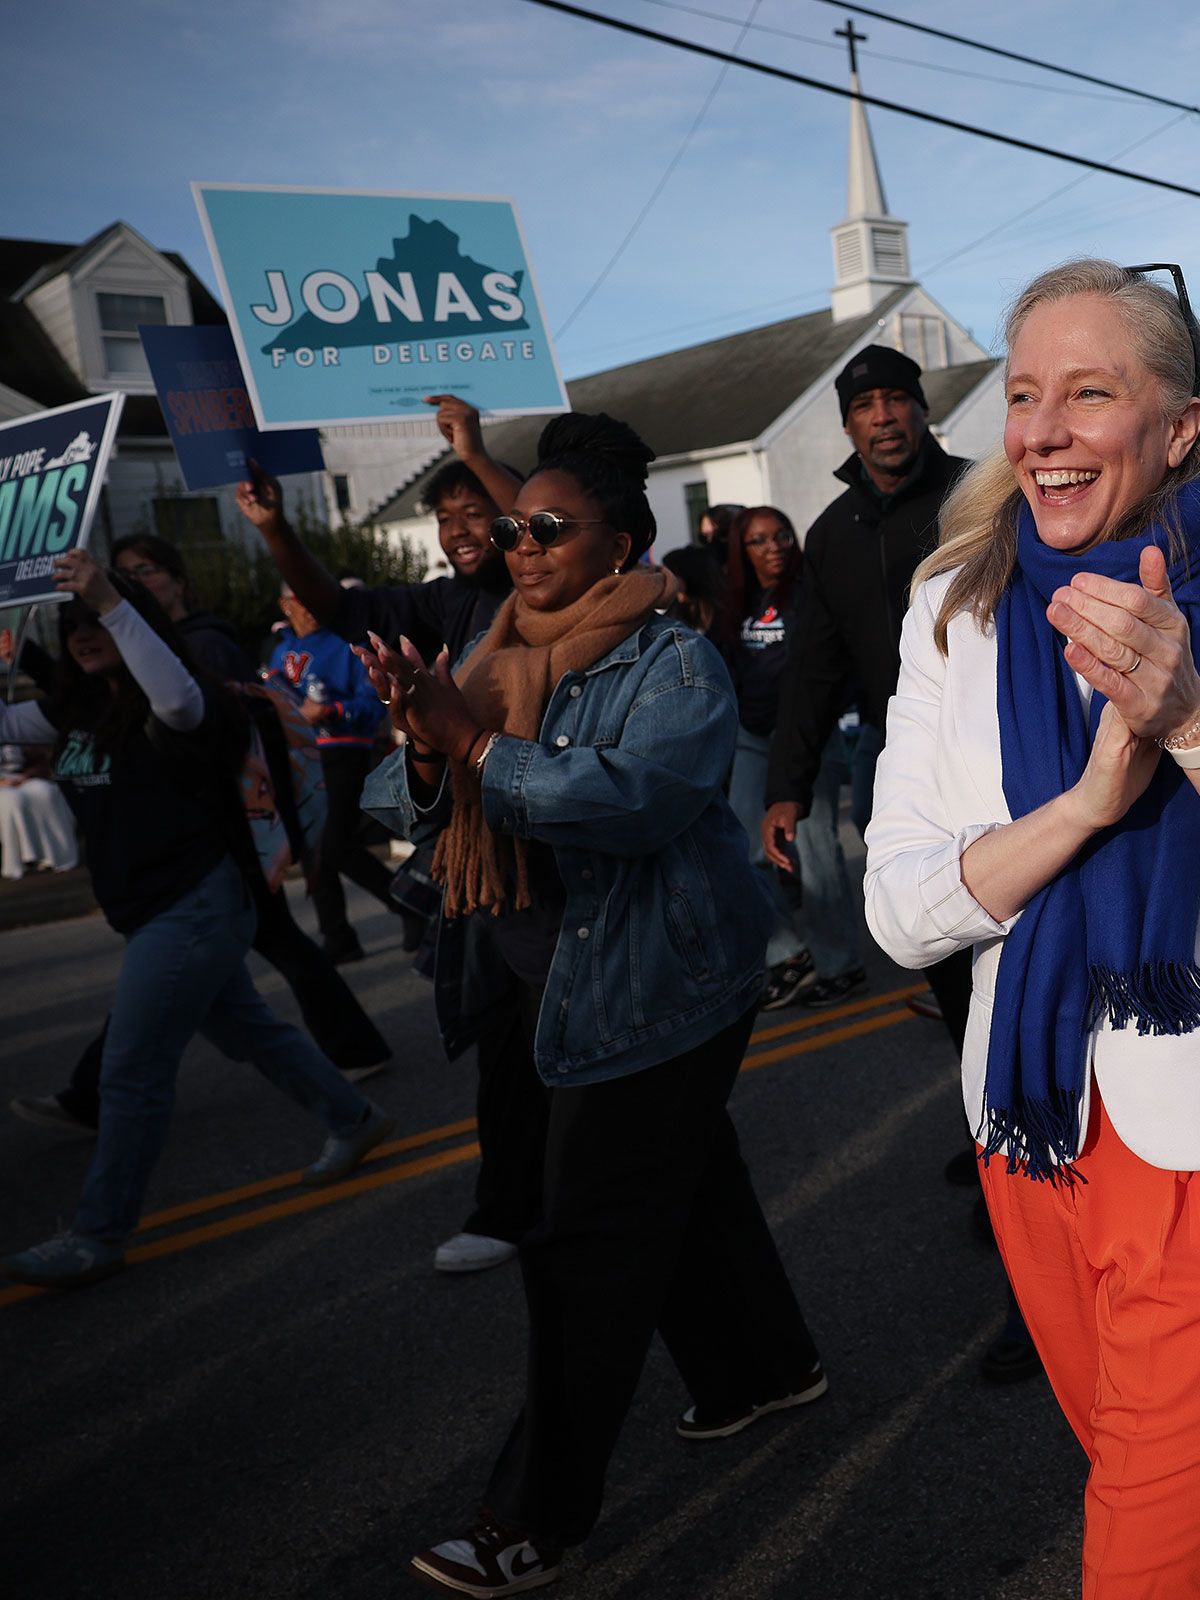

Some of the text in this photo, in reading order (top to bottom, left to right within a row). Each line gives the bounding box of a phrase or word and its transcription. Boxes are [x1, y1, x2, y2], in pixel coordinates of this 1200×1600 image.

[250, 268, 525, 326] JONAS
[271, 340, 536, 368] FOR DELEGATE
